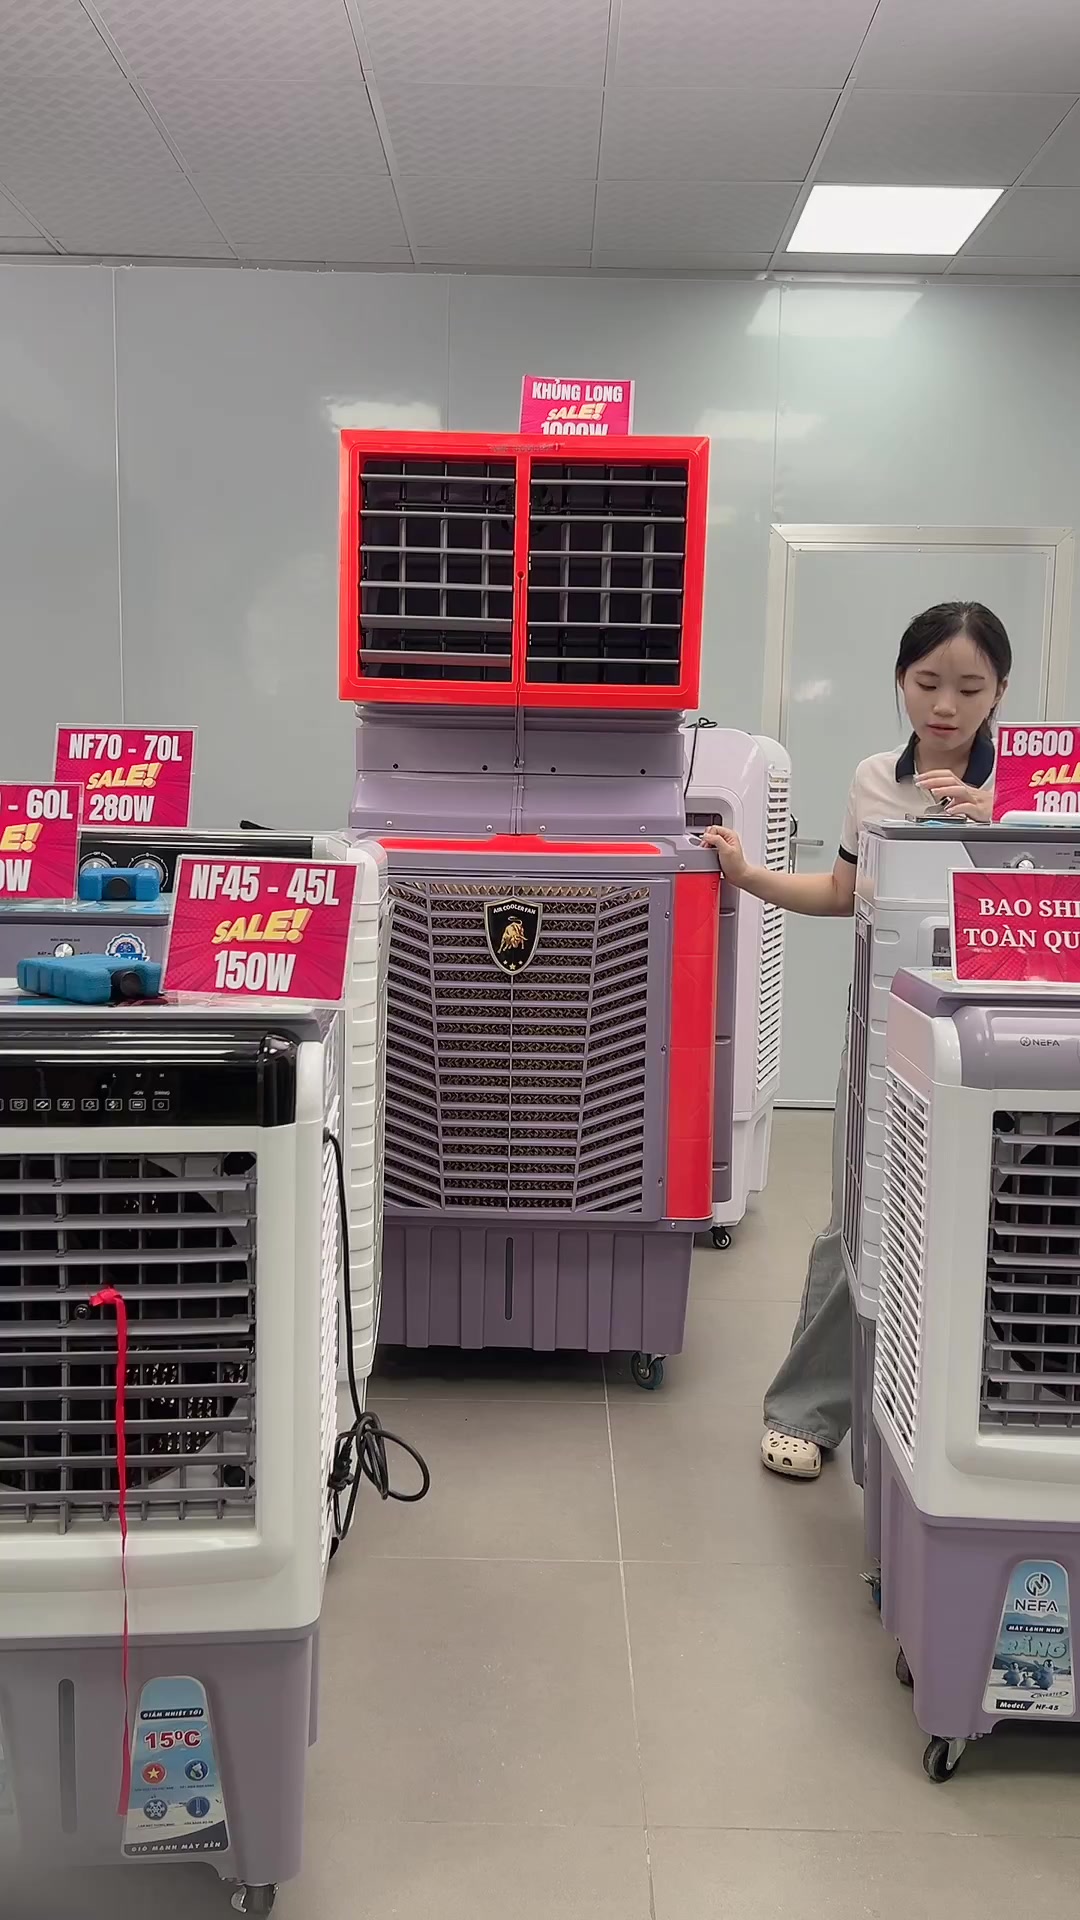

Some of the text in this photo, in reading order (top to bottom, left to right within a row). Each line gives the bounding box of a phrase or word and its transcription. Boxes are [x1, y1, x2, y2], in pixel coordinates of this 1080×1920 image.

[532, 379, 623, 403] KHỦNG LONG
[546, 403, 607, 421] SALE!
[540, 421, 609, 436] 1000W
[69, 733, 123, 760] NF70
[144, 735, 183, 761] 70L
[1000, 730, 1074, 757] L8600
[86, 762, 163, 790] SALE!
[26, 789, 73, 820] 60L
[88, 794, 155, 822] 280W
[189, 864, 261, 902] NF45
[286, 868, 339, 906] 45L
[493, 904, 536, 915] AIR COOLER FAN
[978, 898, 1032, 917] BAO
[211, 908, 313, 944] SALE!
[963, 924, 1037, 947] TOÀN
[214, 950, 297, 992] 150W
[1032, 1039, 1060, 1047] NEFA
[1013, 1598, 1058, 1613] NEFA
